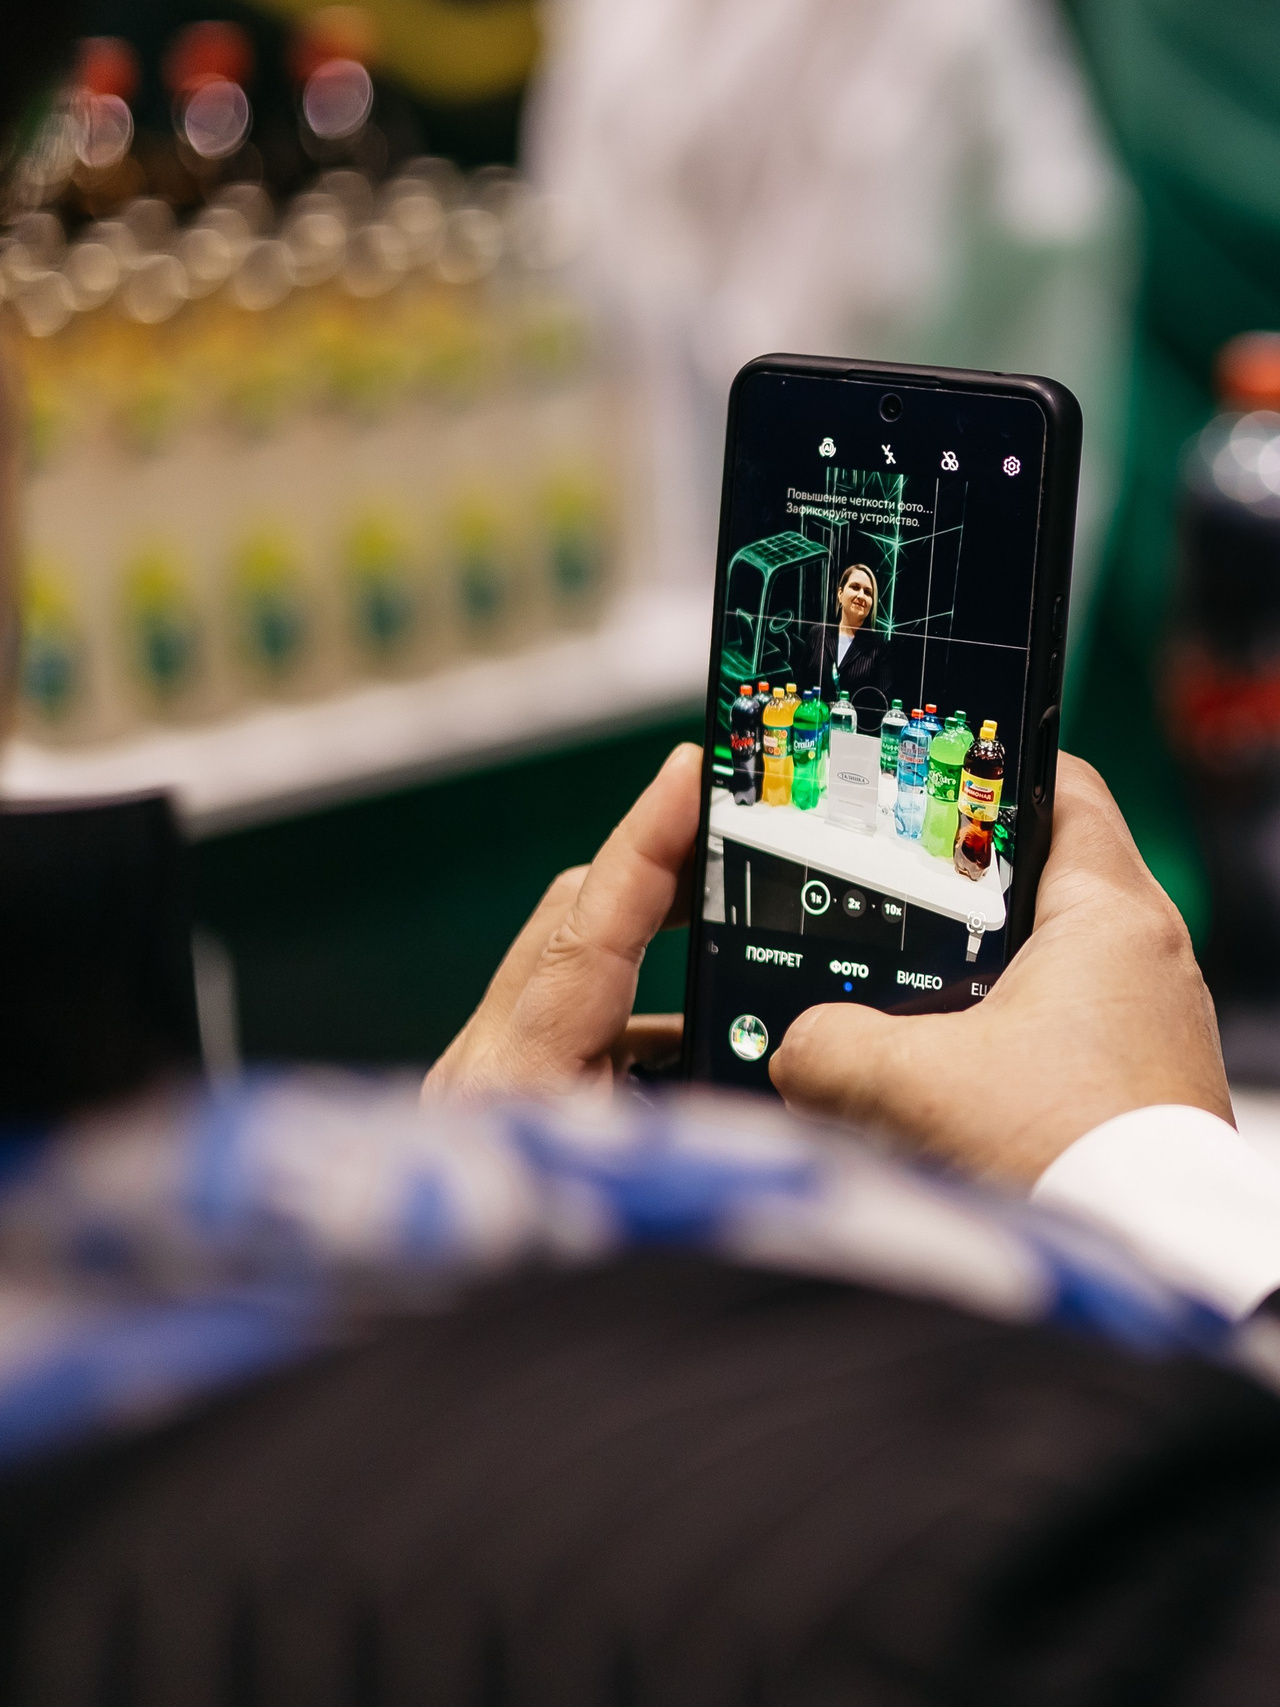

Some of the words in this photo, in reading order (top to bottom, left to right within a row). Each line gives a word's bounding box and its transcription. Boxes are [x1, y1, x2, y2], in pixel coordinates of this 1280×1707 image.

[787, 488, 847, 504] Повышение
[849, 497, 895, 510] четкости
[786, 502, 858, 520] Зафиксируйте
[859, 512, 920, 526] устройство.
[745, 945, 803, 968] ПОРТРЕТ
[829, 960, 869, 979] ФОТО
[896, 970, 943, 990] ВИДЕО
